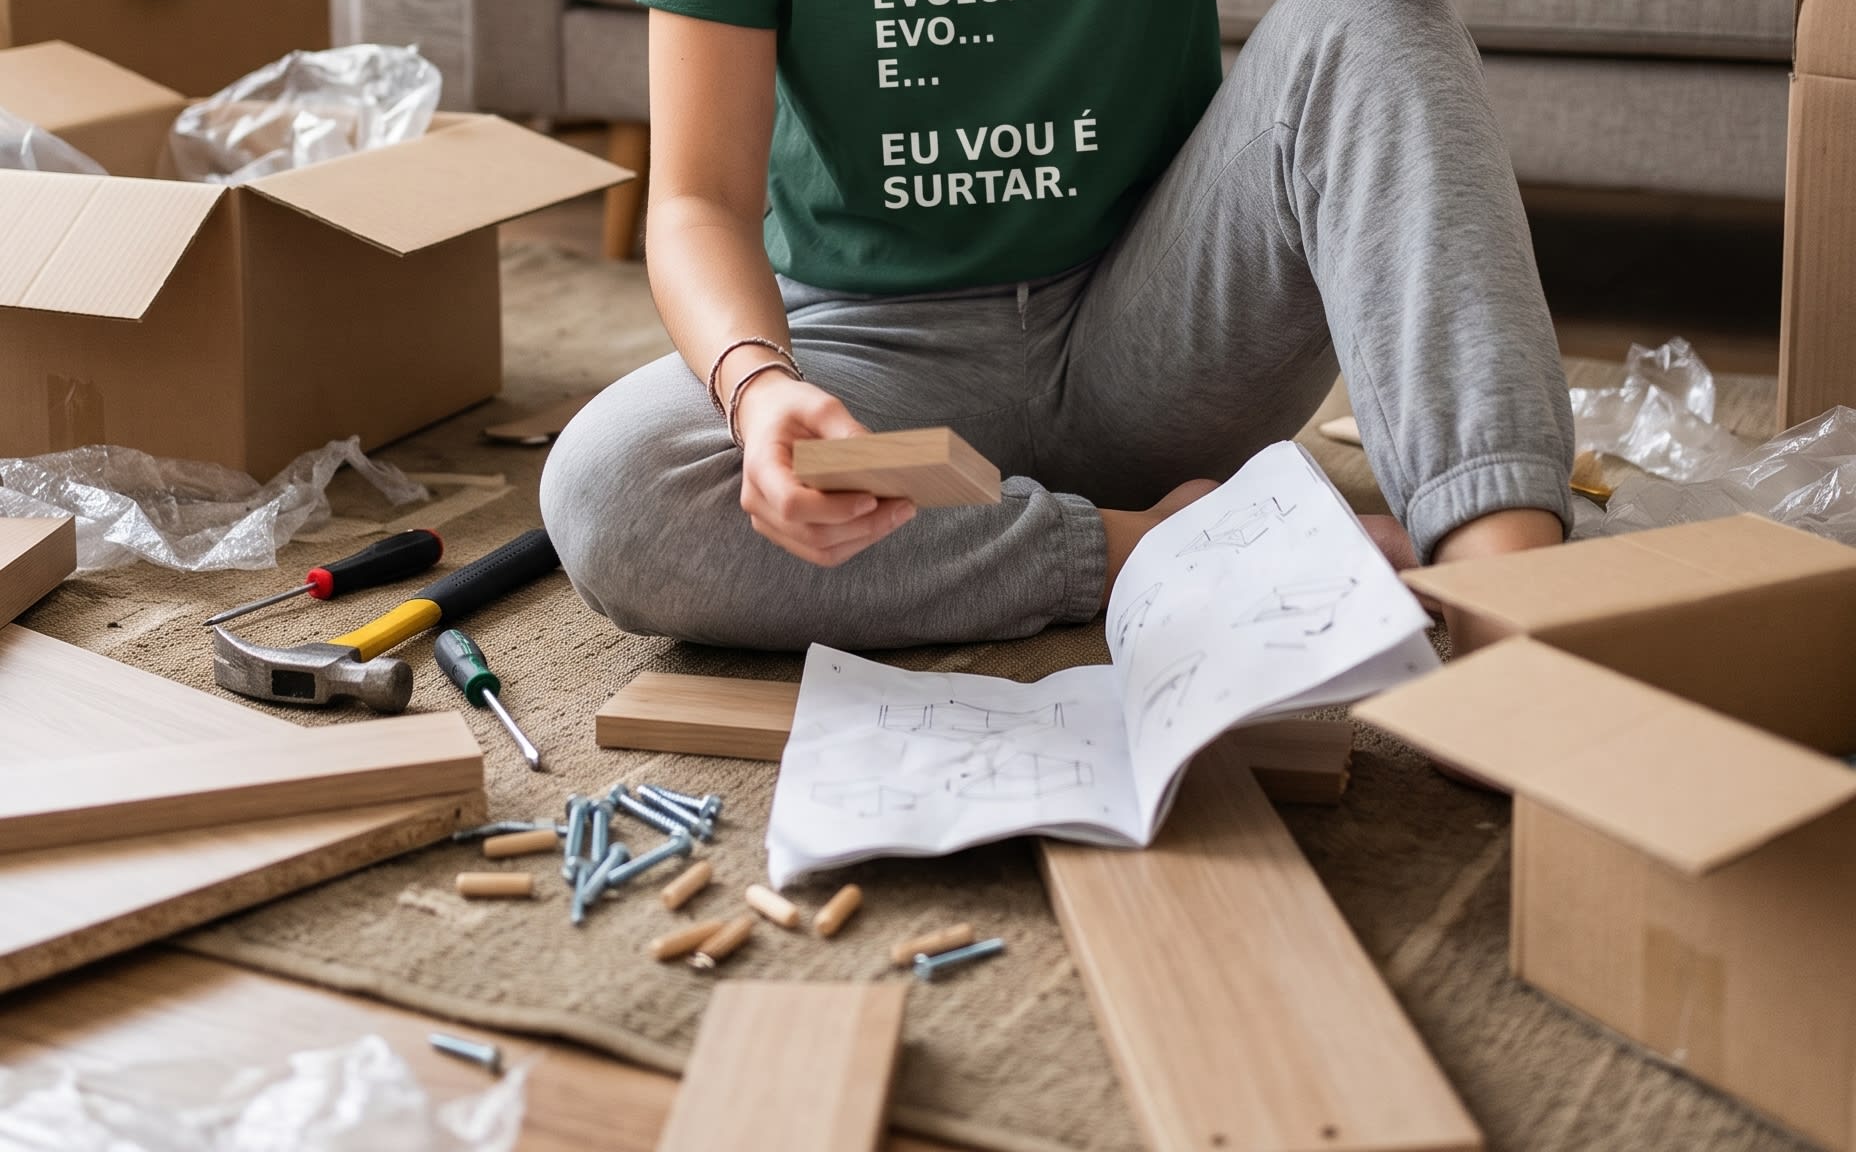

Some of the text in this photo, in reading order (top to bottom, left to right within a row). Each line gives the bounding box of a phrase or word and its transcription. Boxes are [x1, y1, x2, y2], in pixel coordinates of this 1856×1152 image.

[875, 16, 994, 49] EVO...
[878, 58, 939, 88] E...
[881, 108, 1098, 166] EU VOU É
[883, 166, 1077, 209] SURTAR.
